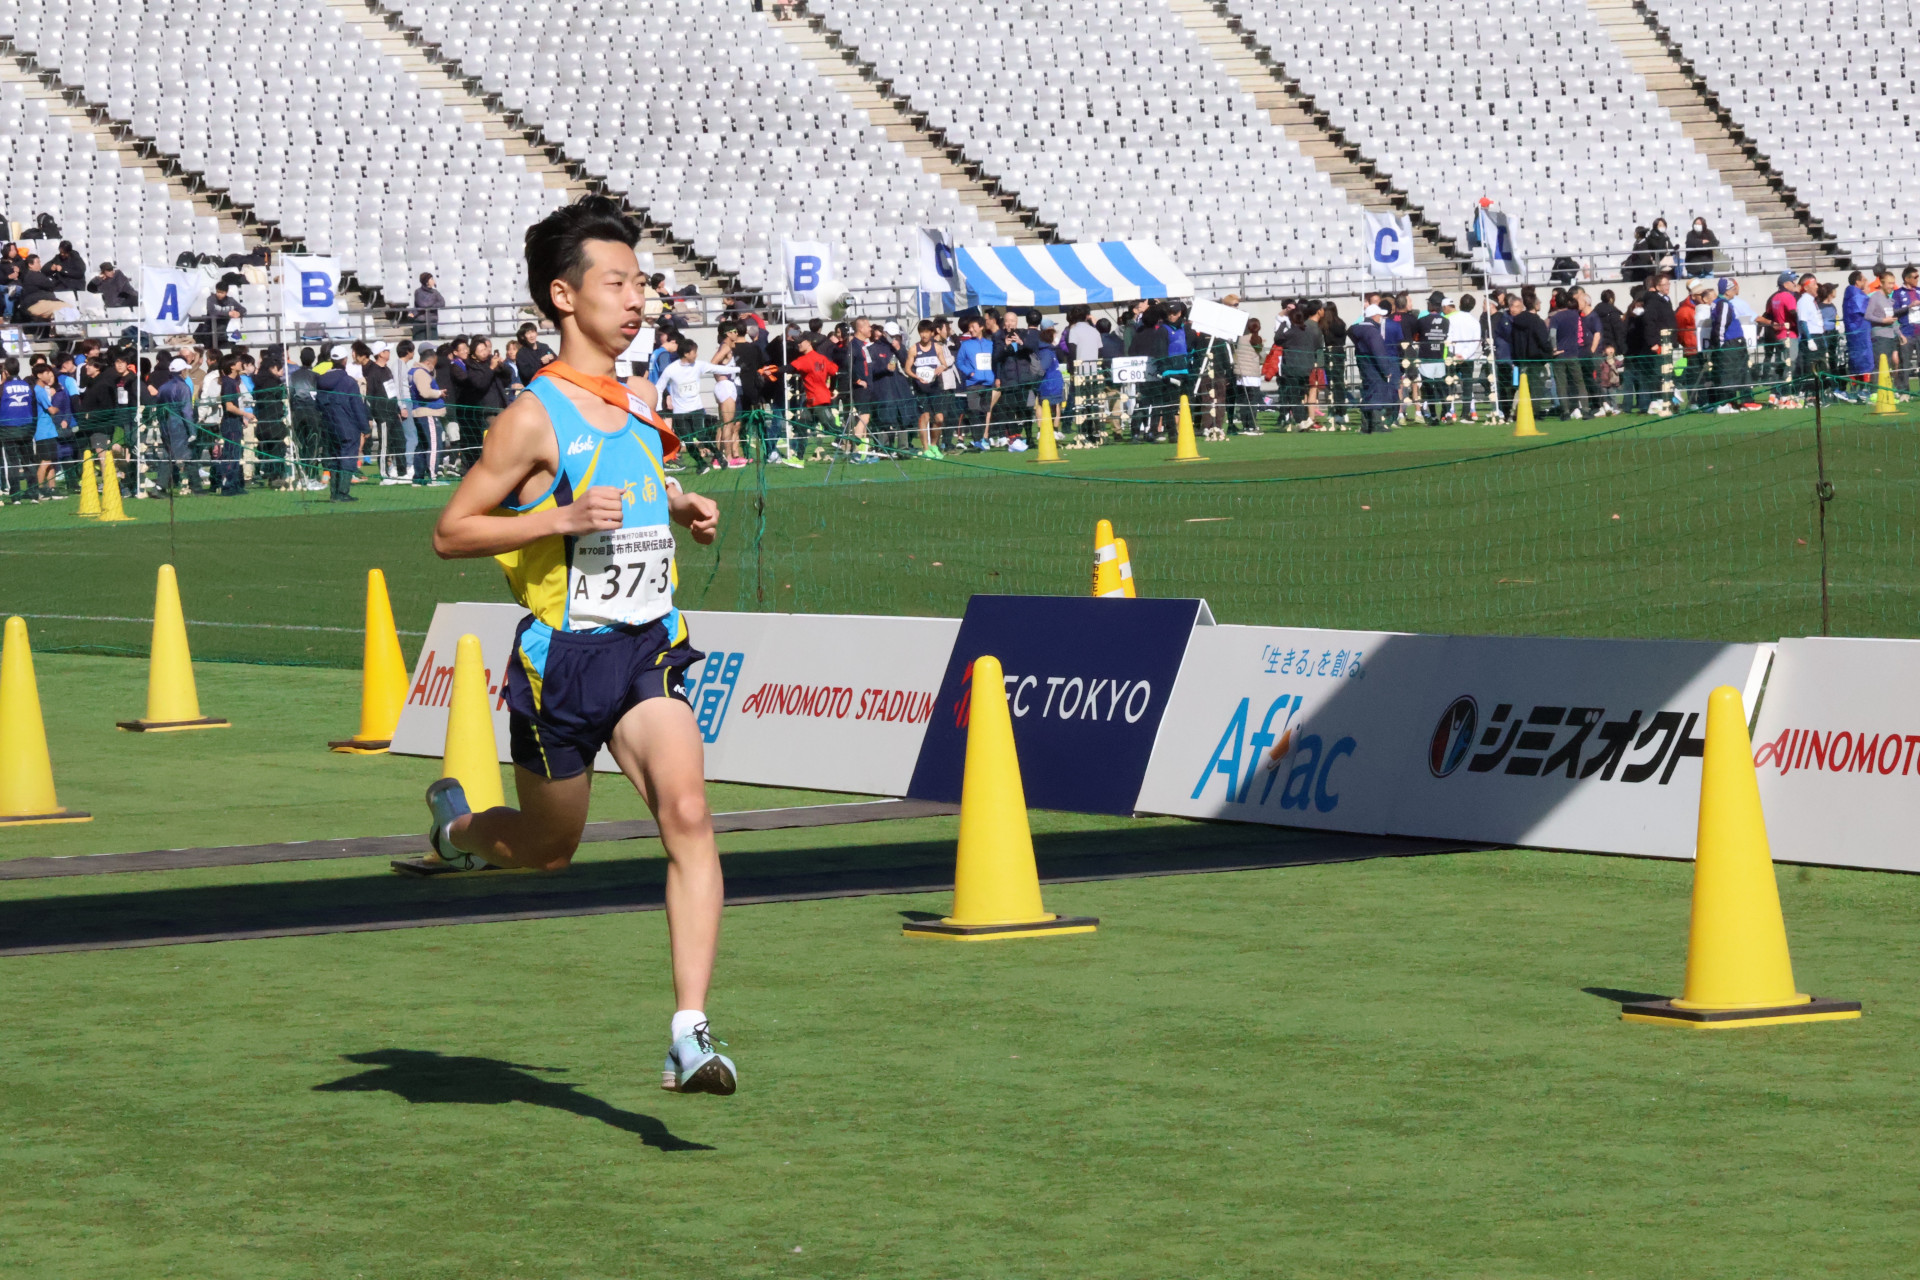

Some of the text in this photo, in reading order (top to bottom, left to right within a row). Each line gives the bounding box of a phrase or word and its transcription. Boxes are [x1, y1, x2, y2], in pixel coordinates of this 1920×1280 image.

[1374, 227, 1400, 263] C
[301, 271, 334, 308] B
[793, 255, 821, 291] B
[156, 283, 180, 321] A
[5, 384, 30, 394] STAFF
[1117, 369, 1128, 382] C
[574, 557, 669, 600] A 37-3
[742, 683, 936, 724] AJINOMOTO STADIUM
[1042, 677, 1151, 723] TOKYO
[1190, 694, 1357, 813] Aflac
[1467, 704, 1704, 784] シミズオクト
[1753, 729, 1920, 777] AJINOMOT
